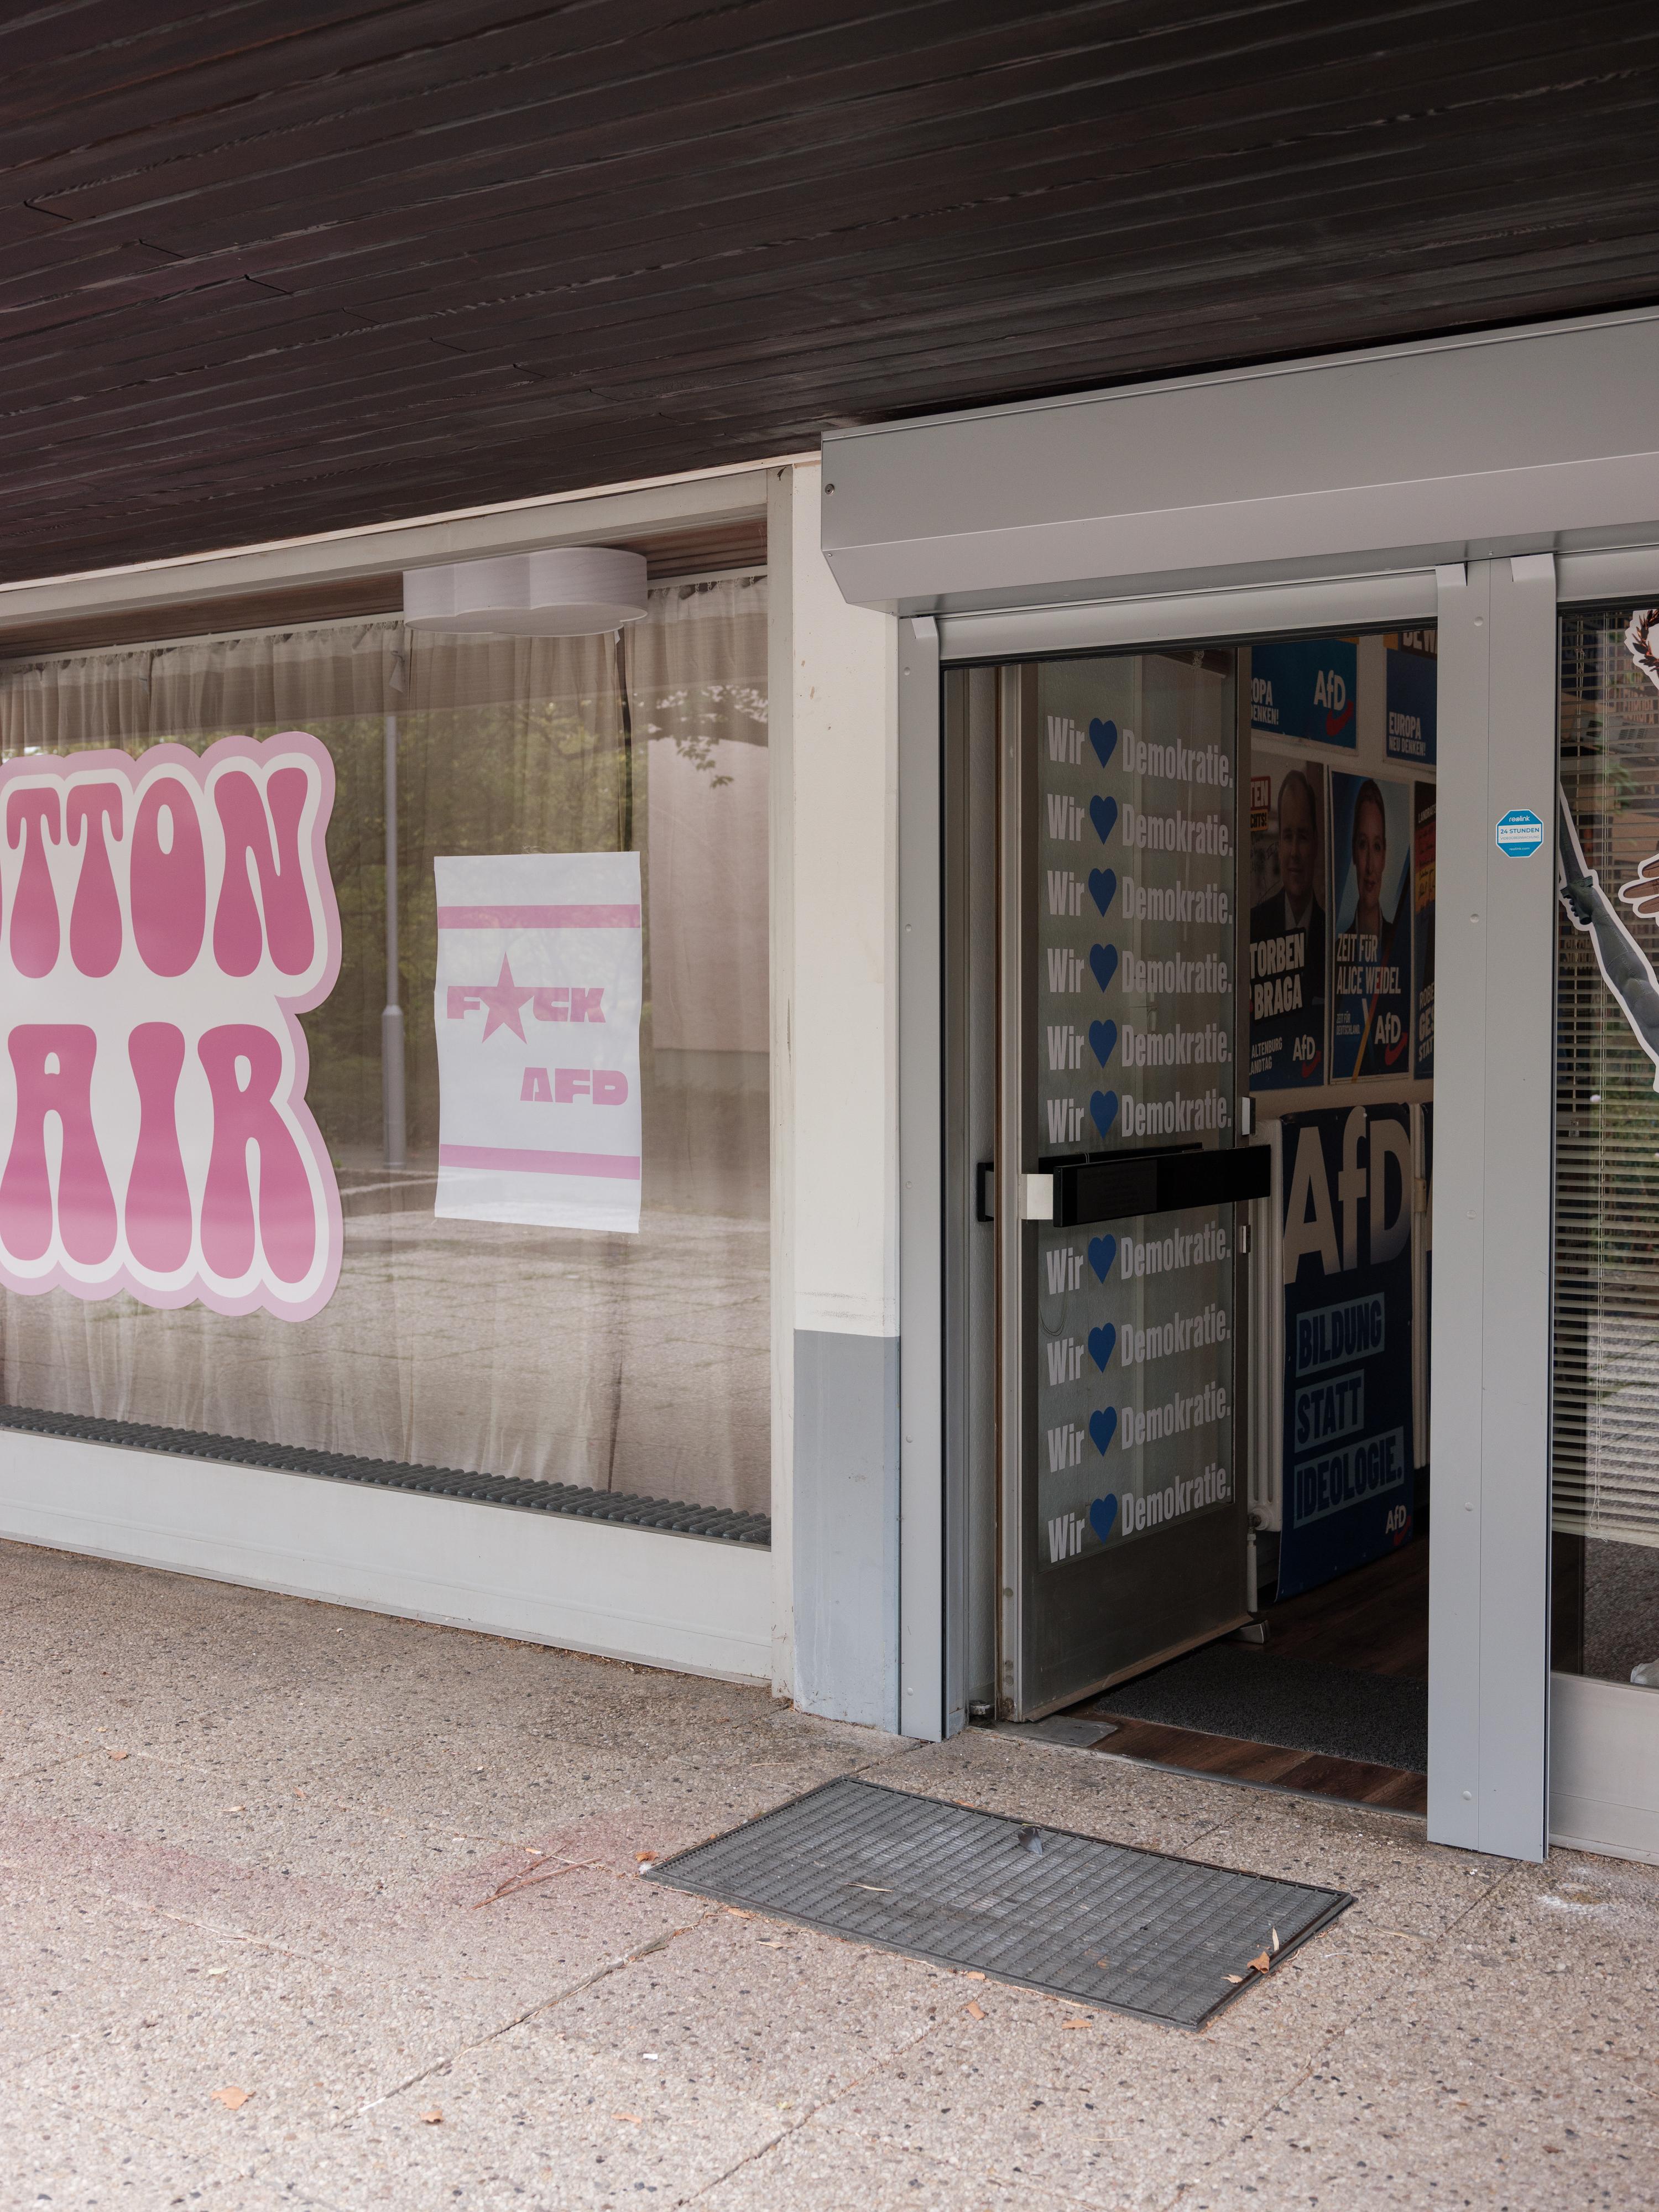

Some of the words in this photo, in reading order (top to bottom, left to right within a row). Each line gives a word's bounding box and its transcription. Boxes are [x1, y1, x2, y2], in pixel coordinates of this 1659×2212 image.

[1250, 677, 1273, 707] OPA
[1314, 669, 1346, 711] AfD
[1389, 711, 1422, 740] EUROPA
[1389, 735, 1400, 752] NEU
[1401, 738, 1426, 757] DENKEN!
[1047, 716, 1085, 765] Wir
[1122, 729, 1234, 788] Demokratie.
[1047, 794, 1085, 842] Wir
[1122, 803, 1233, 857] Demokratie.
[0, 766, 315, 979] TTON
[1047, 870, 1084, 916] Wir
[1122, 876, 1233, 924] Demokratie.
[1047, 948, 1084, 993] Wir
[1121, 951, 1233, 994] Demokratie.
[1250, 932, 1305, 979] TORBEN
[1337, 933, 1358, 962] ZEIT
[1359, 934, 1378, 962] FÜR
[1254, 974, 1303, 1020] BRAGA
[1336, 966, 1364, 994] ALICE
[1365, 966, 1402, 994] WEIDEL
[1047, 1025, 1084, 1071] Wir
[1121, 1022, 1232, 1067] Demokratie.
[1251, 1036, 1283, 1059] ALTENBURG
[1292, 1034, 1316, 1062] AfD
[1374, 1012, 1401, 1045] AfD
[520, 1067, 629, 1105] AFD
[1249, 1058, 1272, 1076] ANDTAG
[1047, 1098, 1084, 1144] Wir
[1121, 1088, 1232, 1138] Demokratie.
[1283, 1105, 1411, 1285] AfD
[1046, 1247, 1084, 1295] Wir
[1120, 1220, 1231, 1280] Demokratie.
[1047, 1337, 1084, 1386] Wir
[1121, 1303, 1231, 1367] Demokratie.
[1298, 1300, 1383, 1370] BILDUNG
[1047, 1423, 1085, 1473] Wir
[1121, 1381, 1232, 1451] Demokratie.
[1297, 1376, 1362, 1445] STATT
[1296, 1435, 1403, 1521] IDEOLOGIE.
[1048, 1512, 1086, 1564] Wir
[1121, 1462, 1232, 1537] Demokratie.
[1385, 1504, 1407, 1535] AfD
